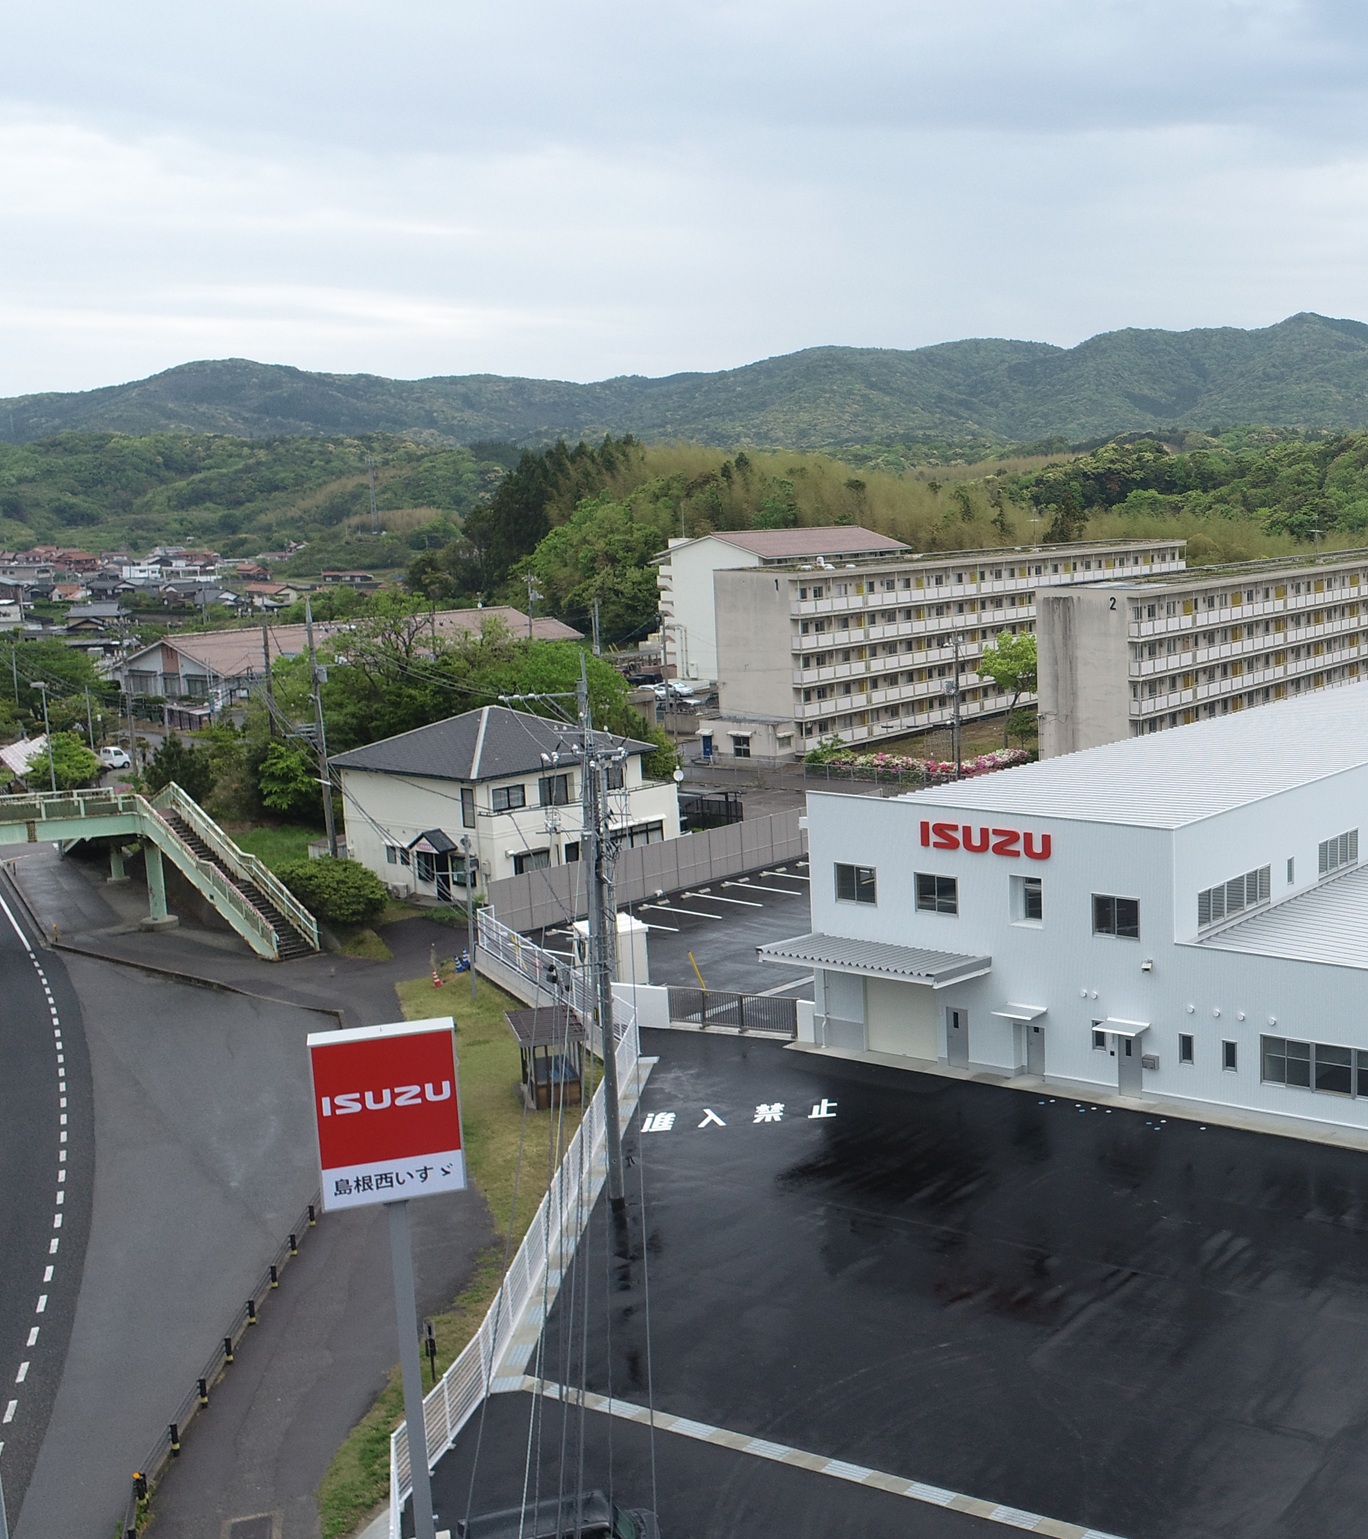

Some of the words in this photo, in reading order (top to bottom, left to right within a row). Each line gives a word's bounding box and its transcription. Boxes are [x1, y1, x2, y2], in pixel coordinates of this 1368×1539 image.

[1109, 596, 1117, 611] 2
[919, 821, 1051, 860] ISUZU
[321, 1080, 451, 1117] ISUZU
[640, 1098, 838, 1133] 進入禁止
[334, 1162, 453, 1196] 島根西いすゞ
